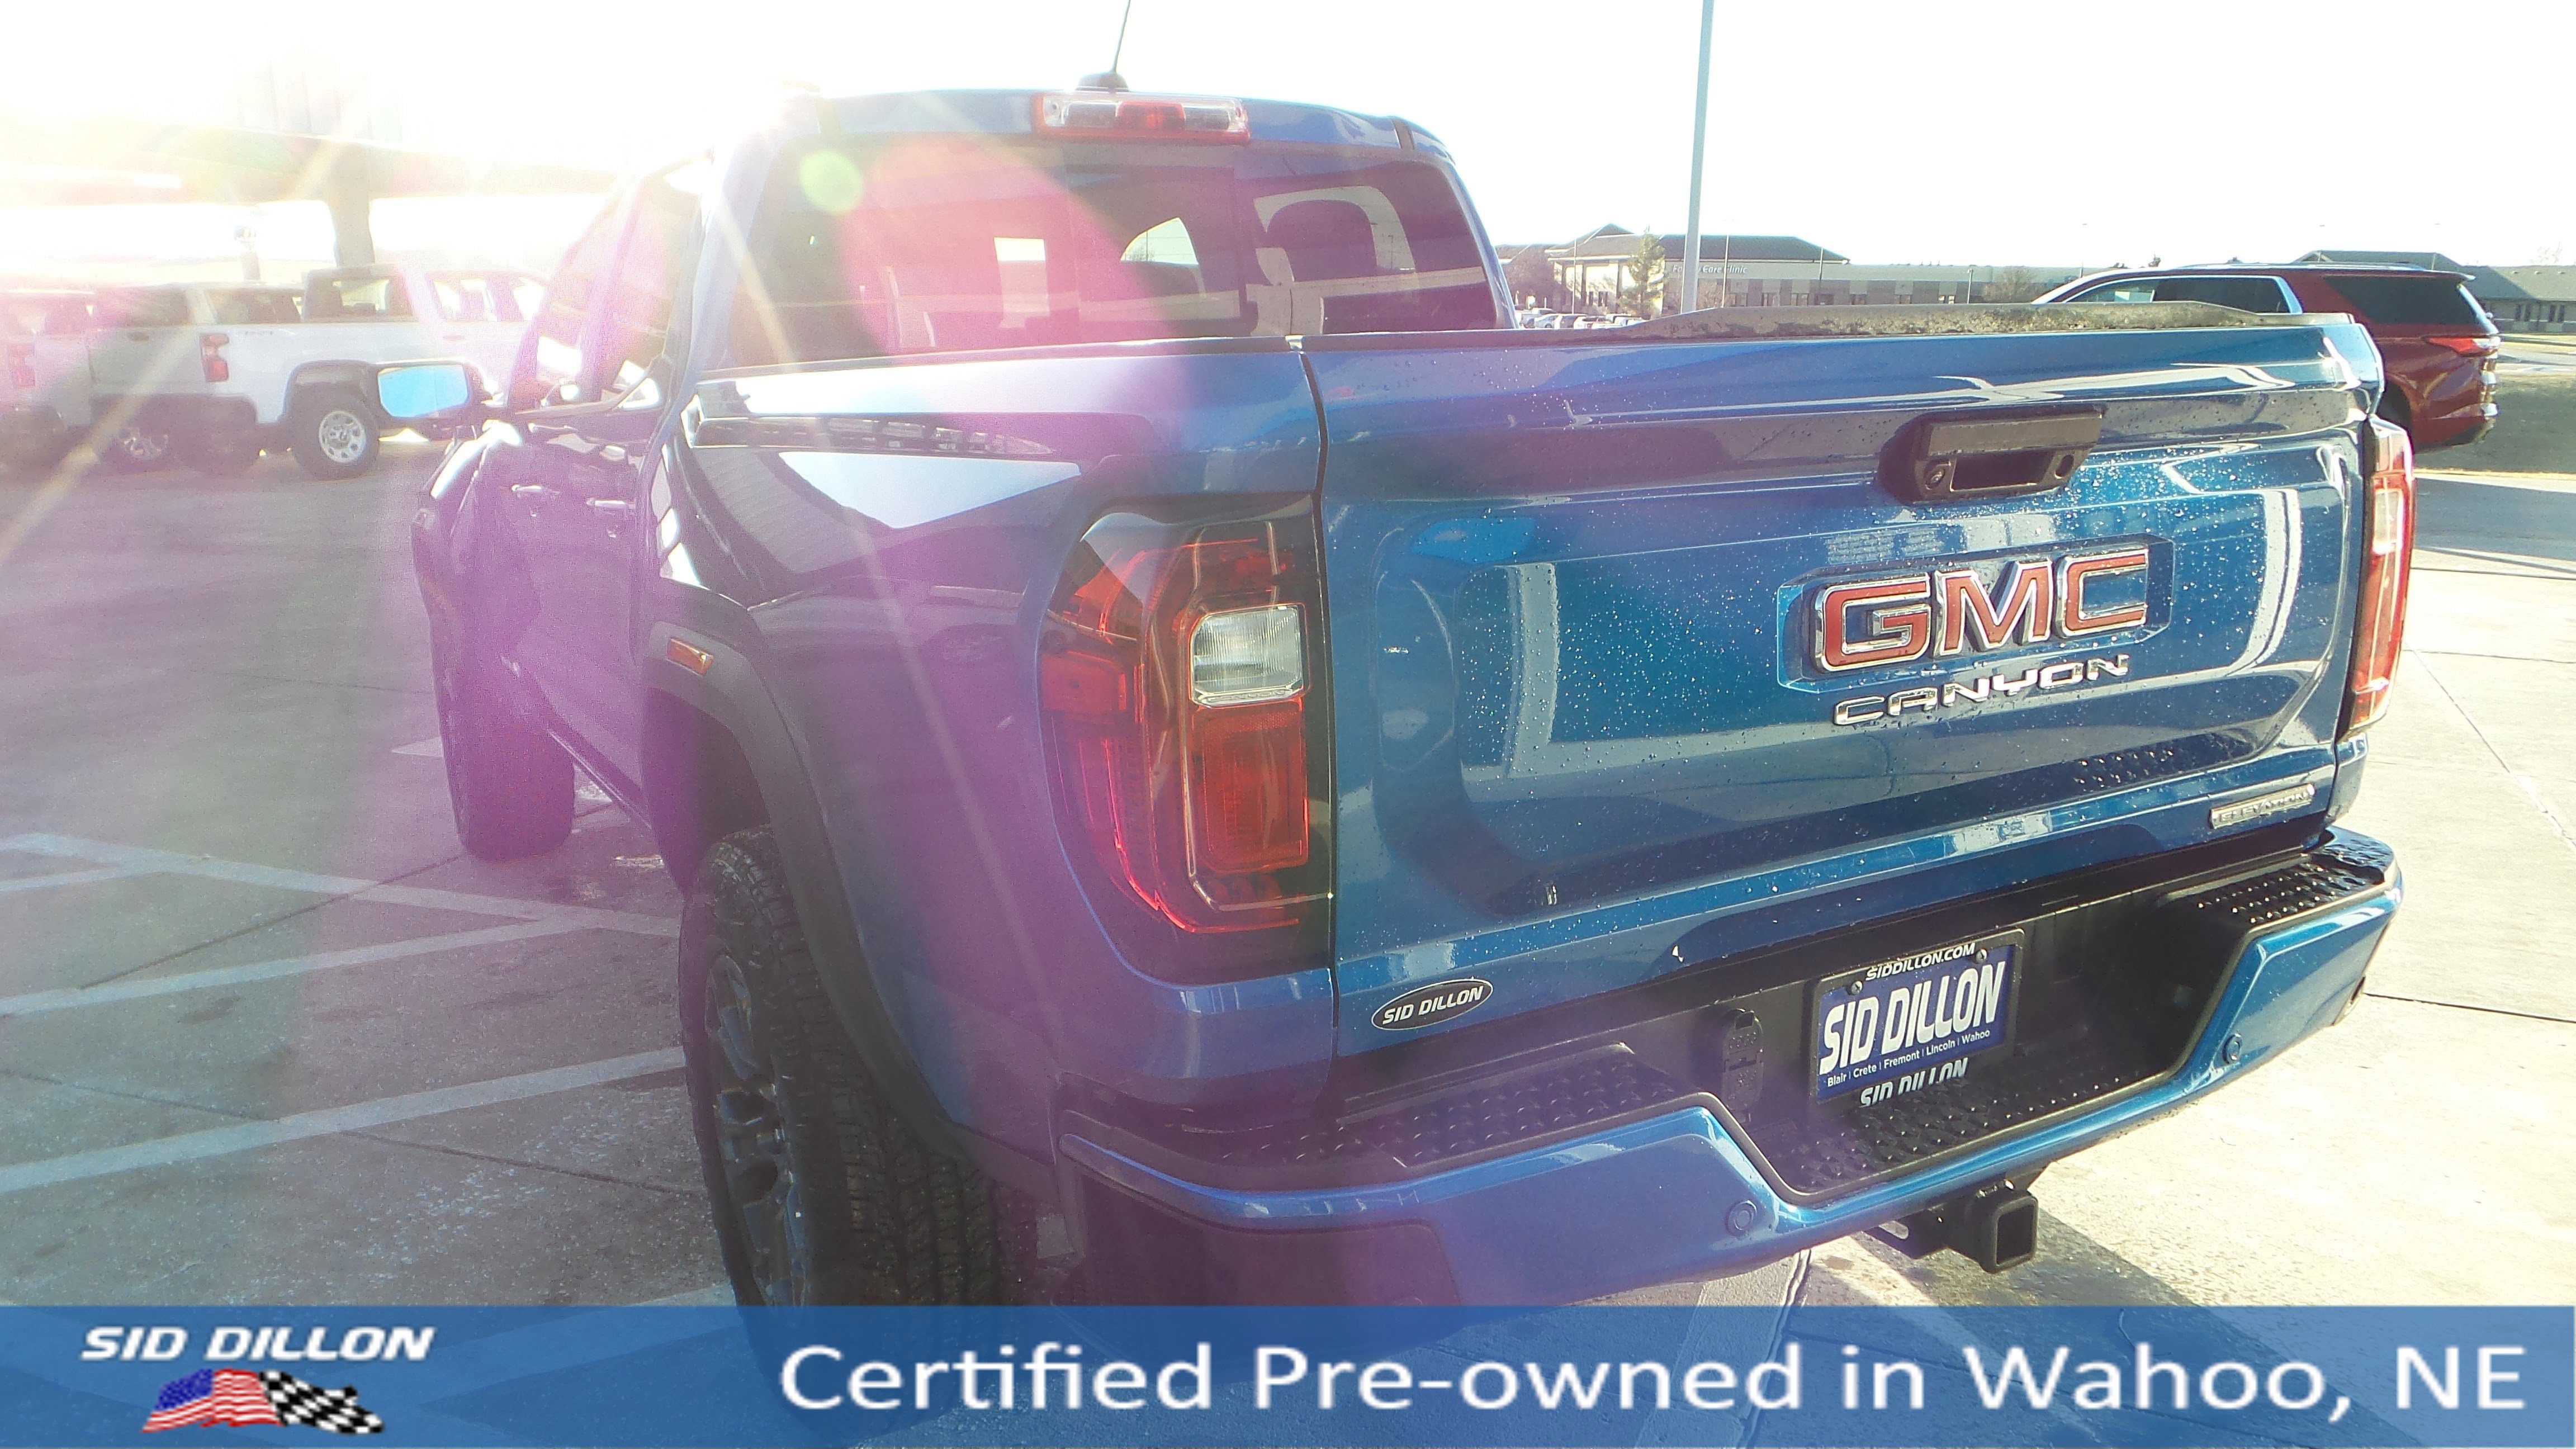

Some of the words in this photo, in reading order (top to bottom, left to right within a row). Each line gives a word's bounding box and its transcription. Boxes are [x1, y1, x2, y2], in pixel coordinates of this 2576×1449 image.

[1812, 544, 2149, 672] GMC
[1833, 654, 2130, 726] CANYON
[1865, 943, 1976, 981] SIDDILLON.COM
[1382, 1004, 1414, 1025] SID
[1418, 986, 1484, 1016] DILLON
[1819, 996, 1879, 1075] SID
[1881, 961, 2006, 1055] DILLON
[1827, 1073, 1846, 1087] Blair
[1853, 1064, 1877, 1078] Crete
[1884, 1050, 1920, 1069] Fremont
[1926, 1039, 1955, 1056] Lincoln
[1962, 1030, 1991, 1044] Wahoo
